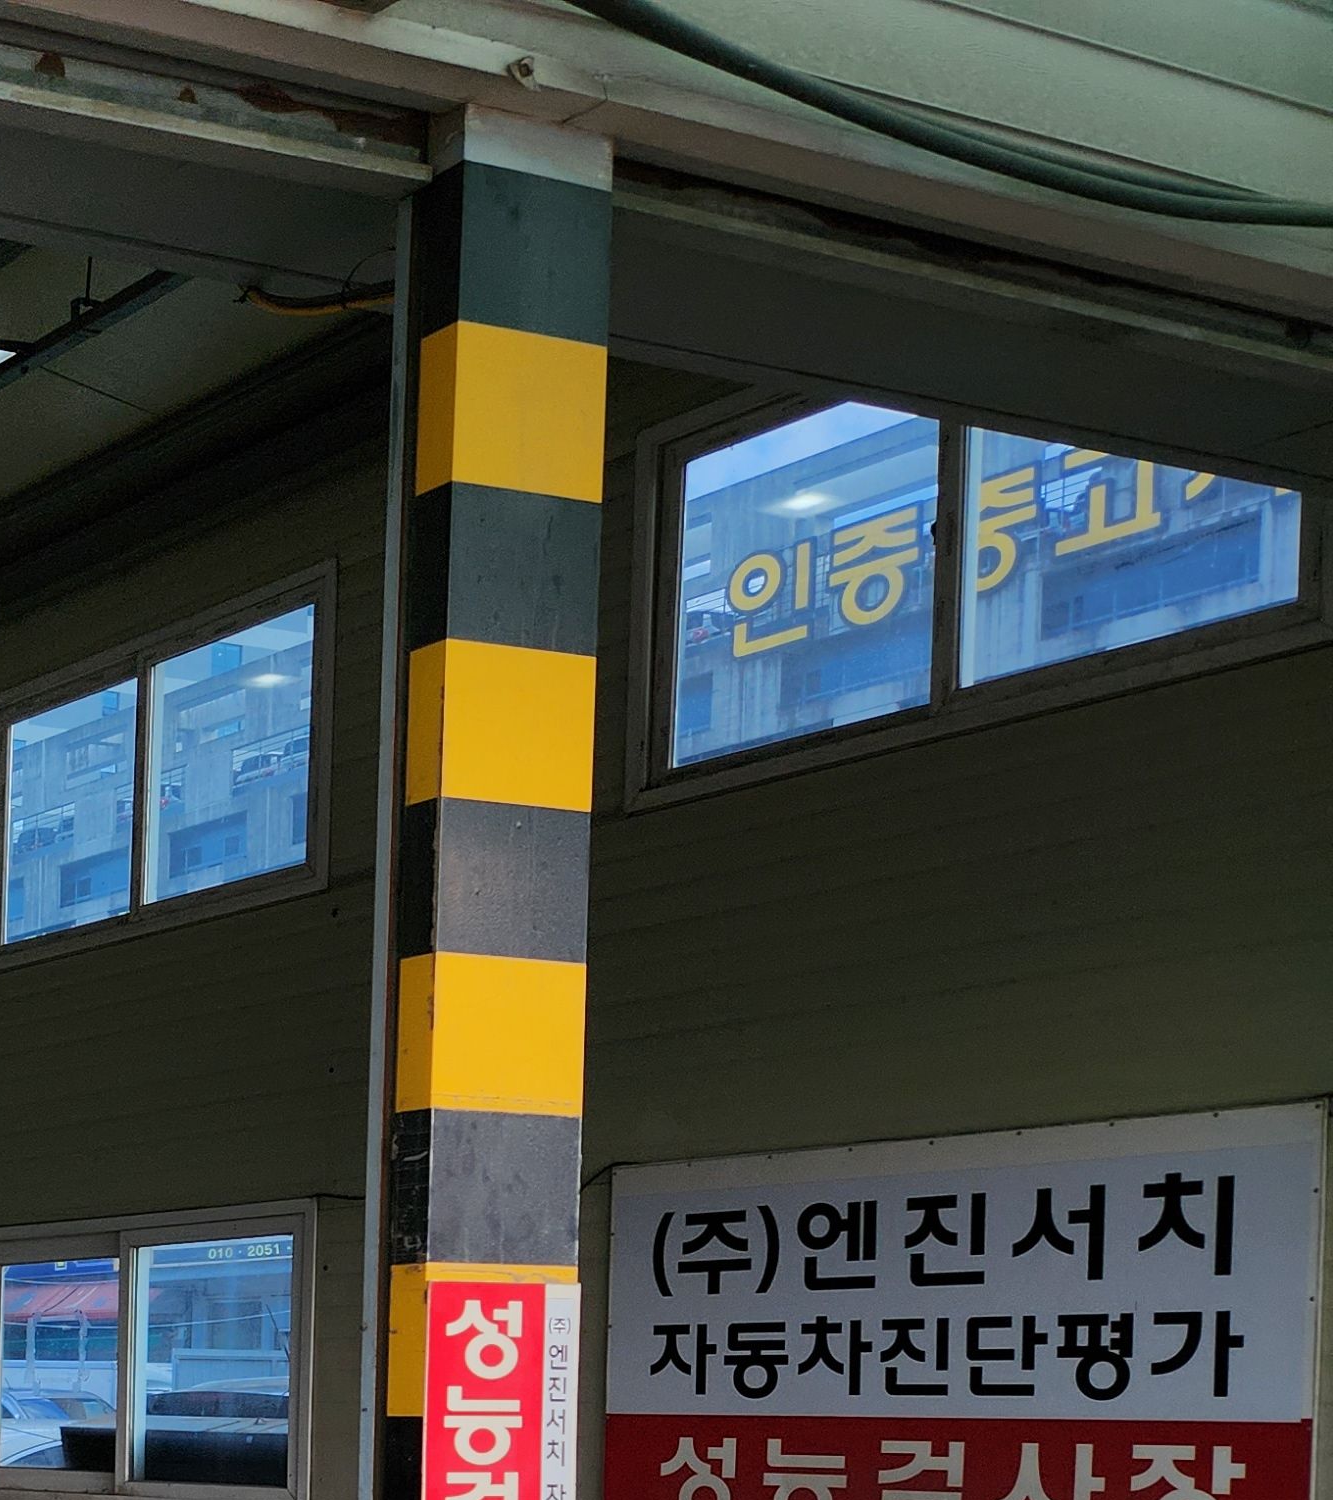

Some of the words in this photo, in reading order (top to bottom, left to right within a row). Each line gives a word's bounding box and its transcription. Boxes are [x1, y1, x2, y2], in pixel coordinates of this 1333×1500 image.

[208, 1247, 233, 1260] 010
[247, 1243, 280, 1258] 2051
[650, 1170, 1237, 1298] (주)엔진서치
[648, 1309, 1246, 1402] 자동차진단평가
